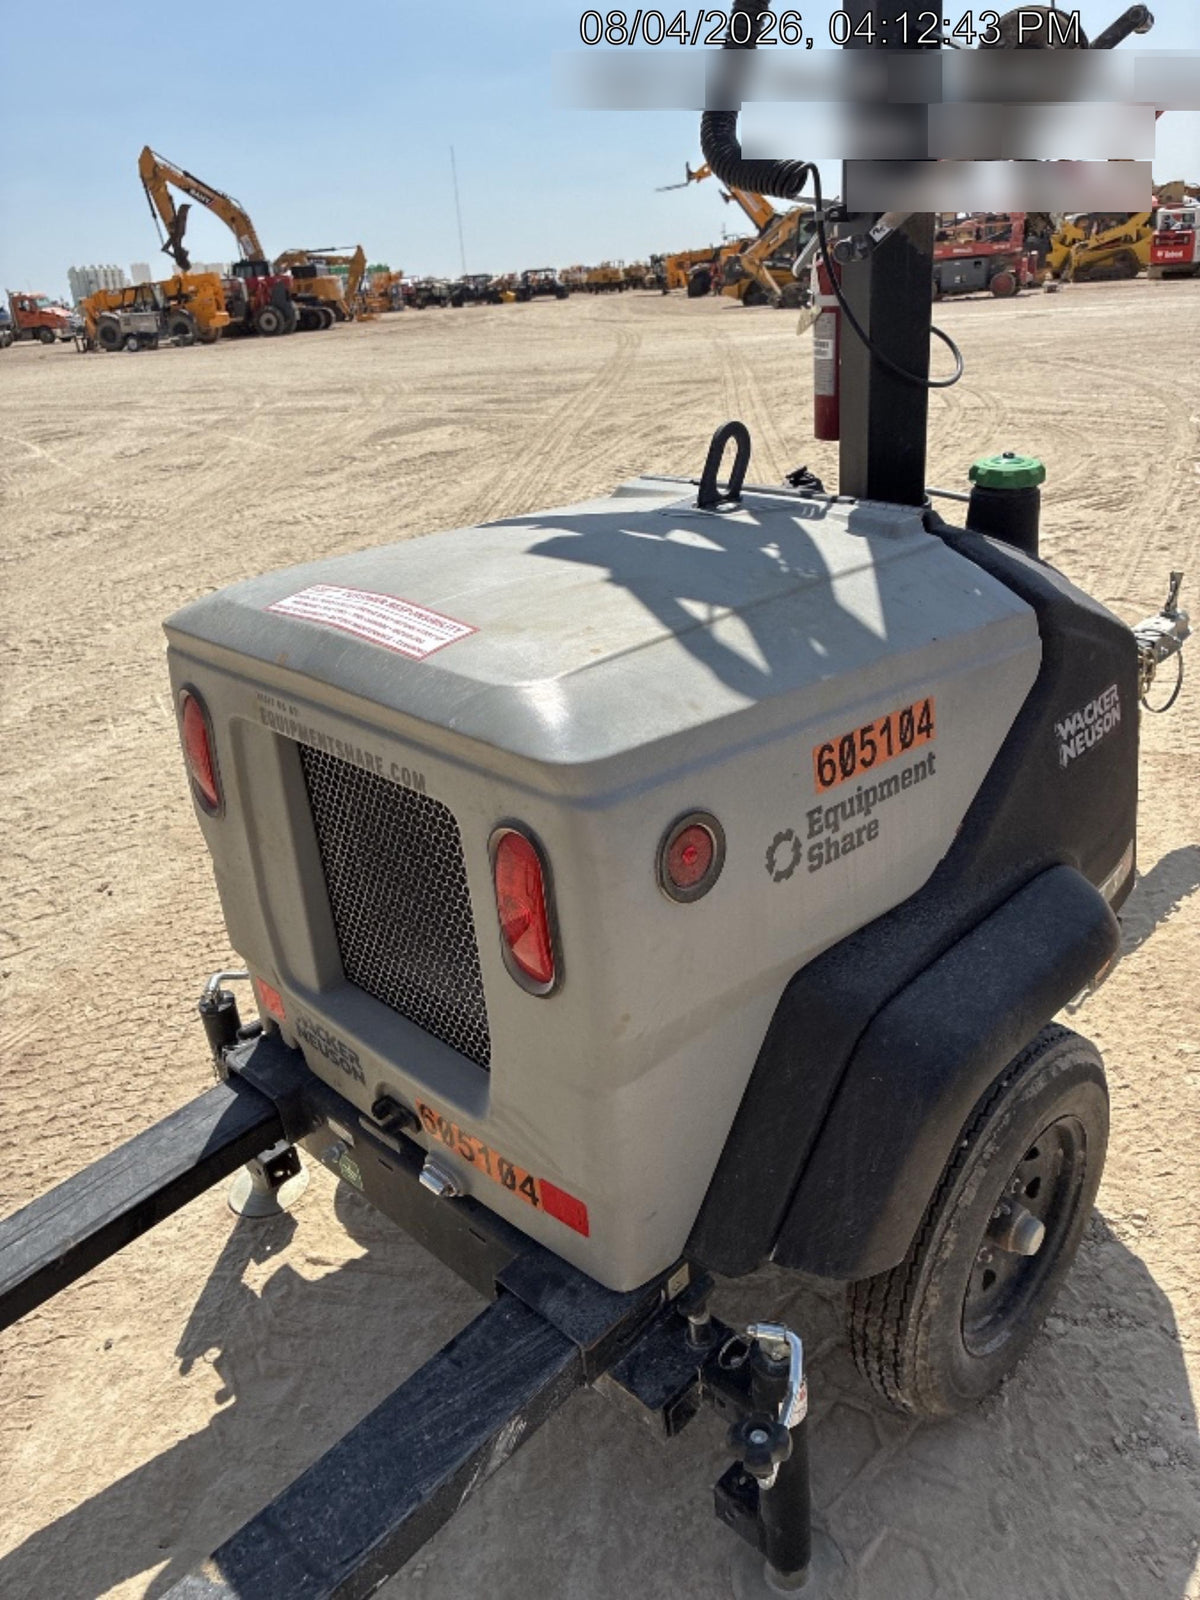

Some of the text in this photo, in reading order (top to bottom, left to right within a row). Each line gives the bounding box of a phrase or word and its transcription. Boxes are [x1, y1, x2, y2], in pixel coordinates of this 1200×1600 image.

[817, 697, 934, 788] 605104
[1055, 684, 1119, 740] WACKER
[1060, 702, 1121, 768] NEUSON
[806, 731, 936, 840] Equipment
[807, 818, 879, 873] Share
[419, 1103, 540, 1207] 605104
